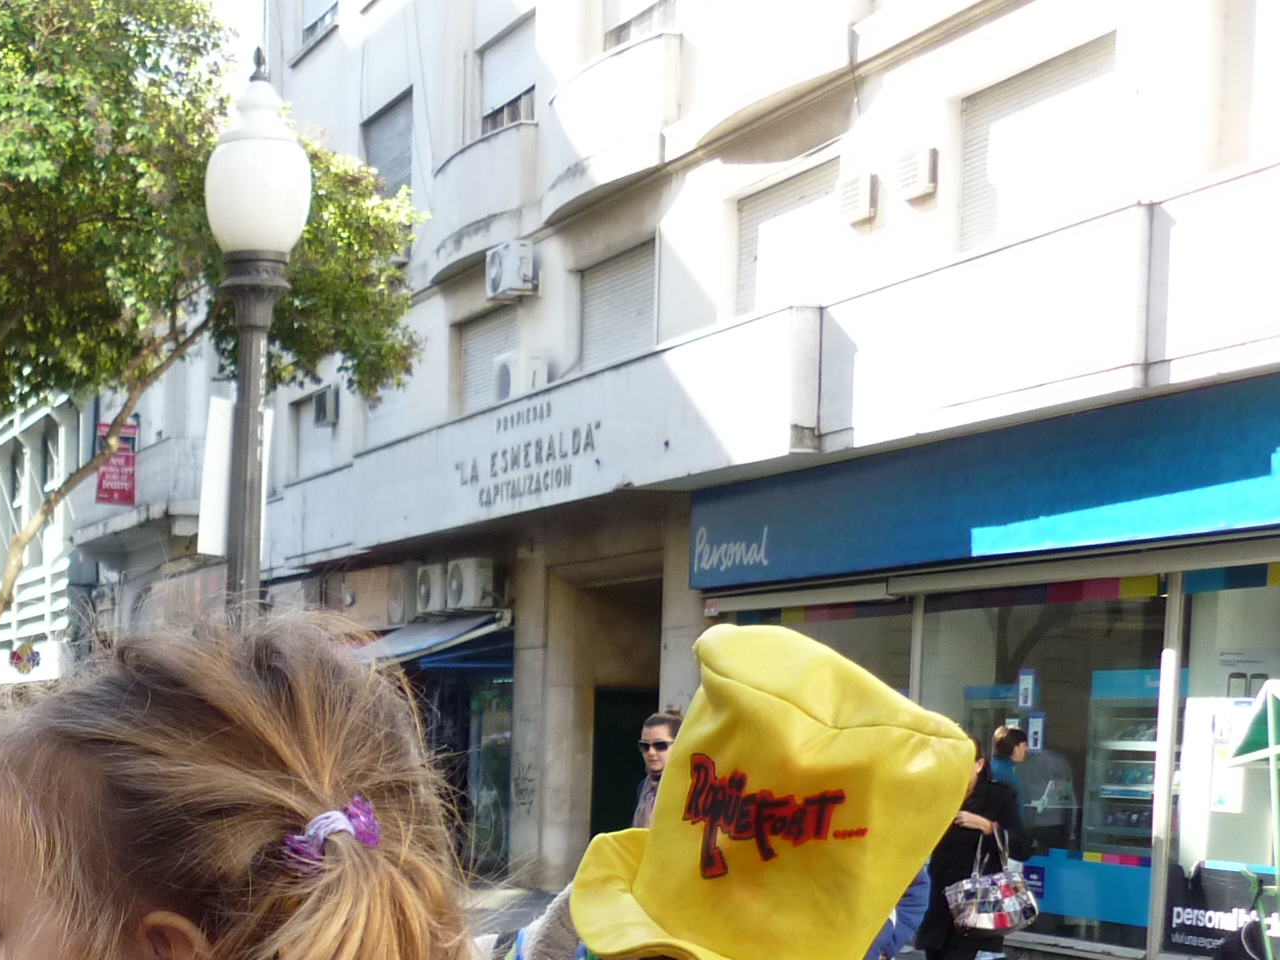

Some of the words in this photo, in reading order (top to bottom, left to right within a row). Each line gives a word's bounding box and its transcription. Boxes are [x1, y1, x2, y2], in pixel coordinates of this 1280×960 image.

[496, 401, 552, 434] PROPIEDAD
[693, 525, 769, 574] Personal
[1172, 906, 1238, 932] personal
